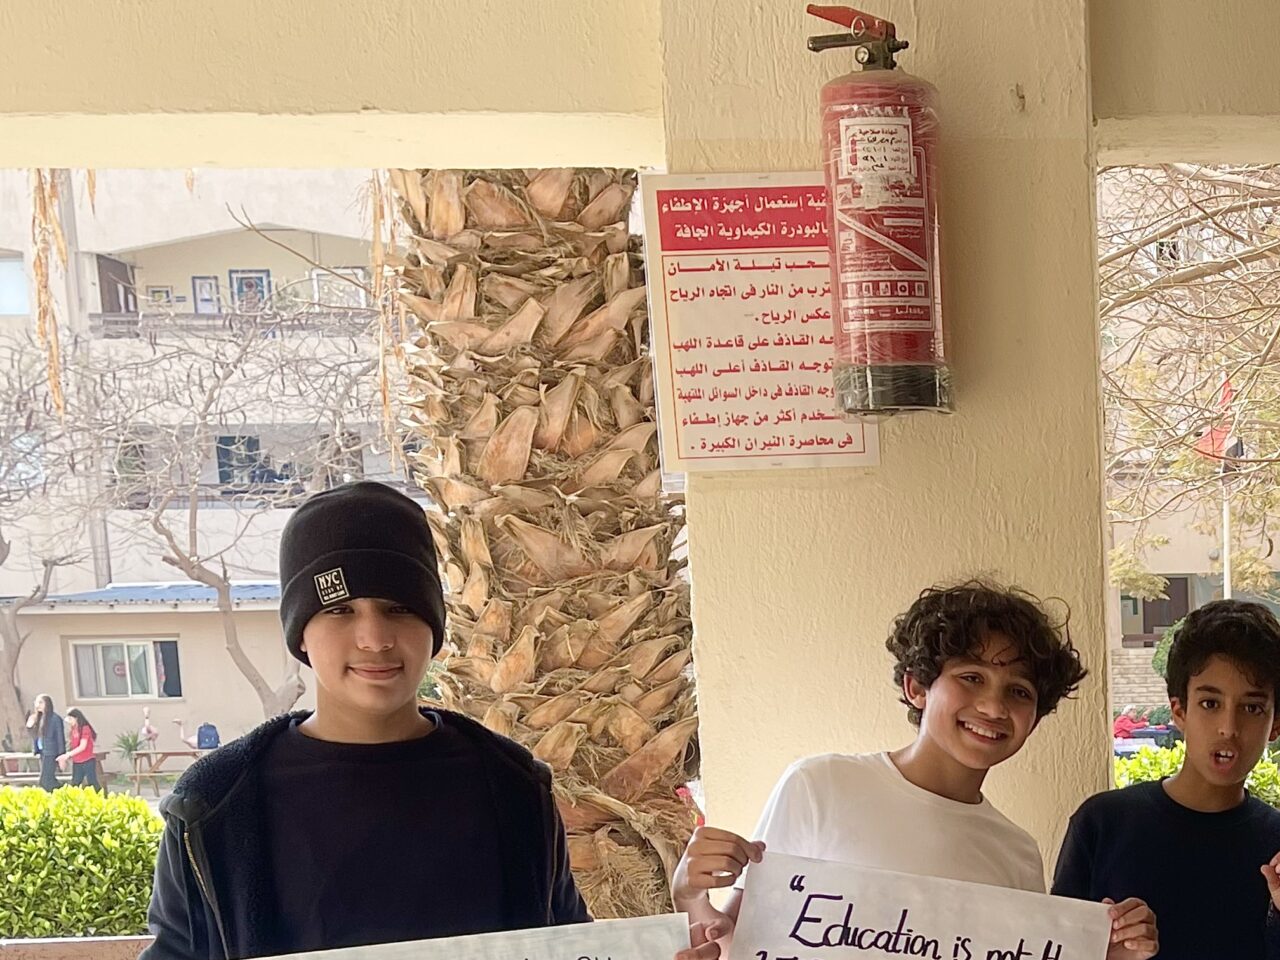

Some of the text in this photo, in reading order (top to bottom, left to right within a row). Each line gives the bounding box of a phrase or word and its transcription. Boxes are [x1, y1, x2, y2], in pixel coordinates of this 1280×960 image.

[661, 196, 707, 215] الإطفاء
[713, 193, 749, 214] أجهزة
[754, 193, 803, 213] إستعمال
[675, 224, 714, 242] الجافة
[717, 221, 776, 240] الكيماوية
[669, 286, 705, 302] الرياح
[708, 284, 736, 301] اتجاه
[760, 283, 784, 299] النار
[788, 283, 804, 298] من
[800, 306, 832, 324] عكس
[672, 336, 702, 352] اللهب
[706, 334, 745, 349] قاعدة
[773, 332, 814, 347] القاذف
[675, 362, 708, 378] اللهب
[749, 357, 794, 373] القاذف
[708, 386, 741, 402] السوائل
[744, 385, 768, 401] داخل
[785, 382, 814, 398] القاذف
[681, 412, 721, 428] إطفاء
[723, 411, 749, 426] جهاز
[753, 410, 769, 426] من
[773, 407, 797, 425] أكثر
[744, 435, 785, 451] النيران
[788, 434, 834, 450] محاصرة
[318, 571, 340, 589] NYC
